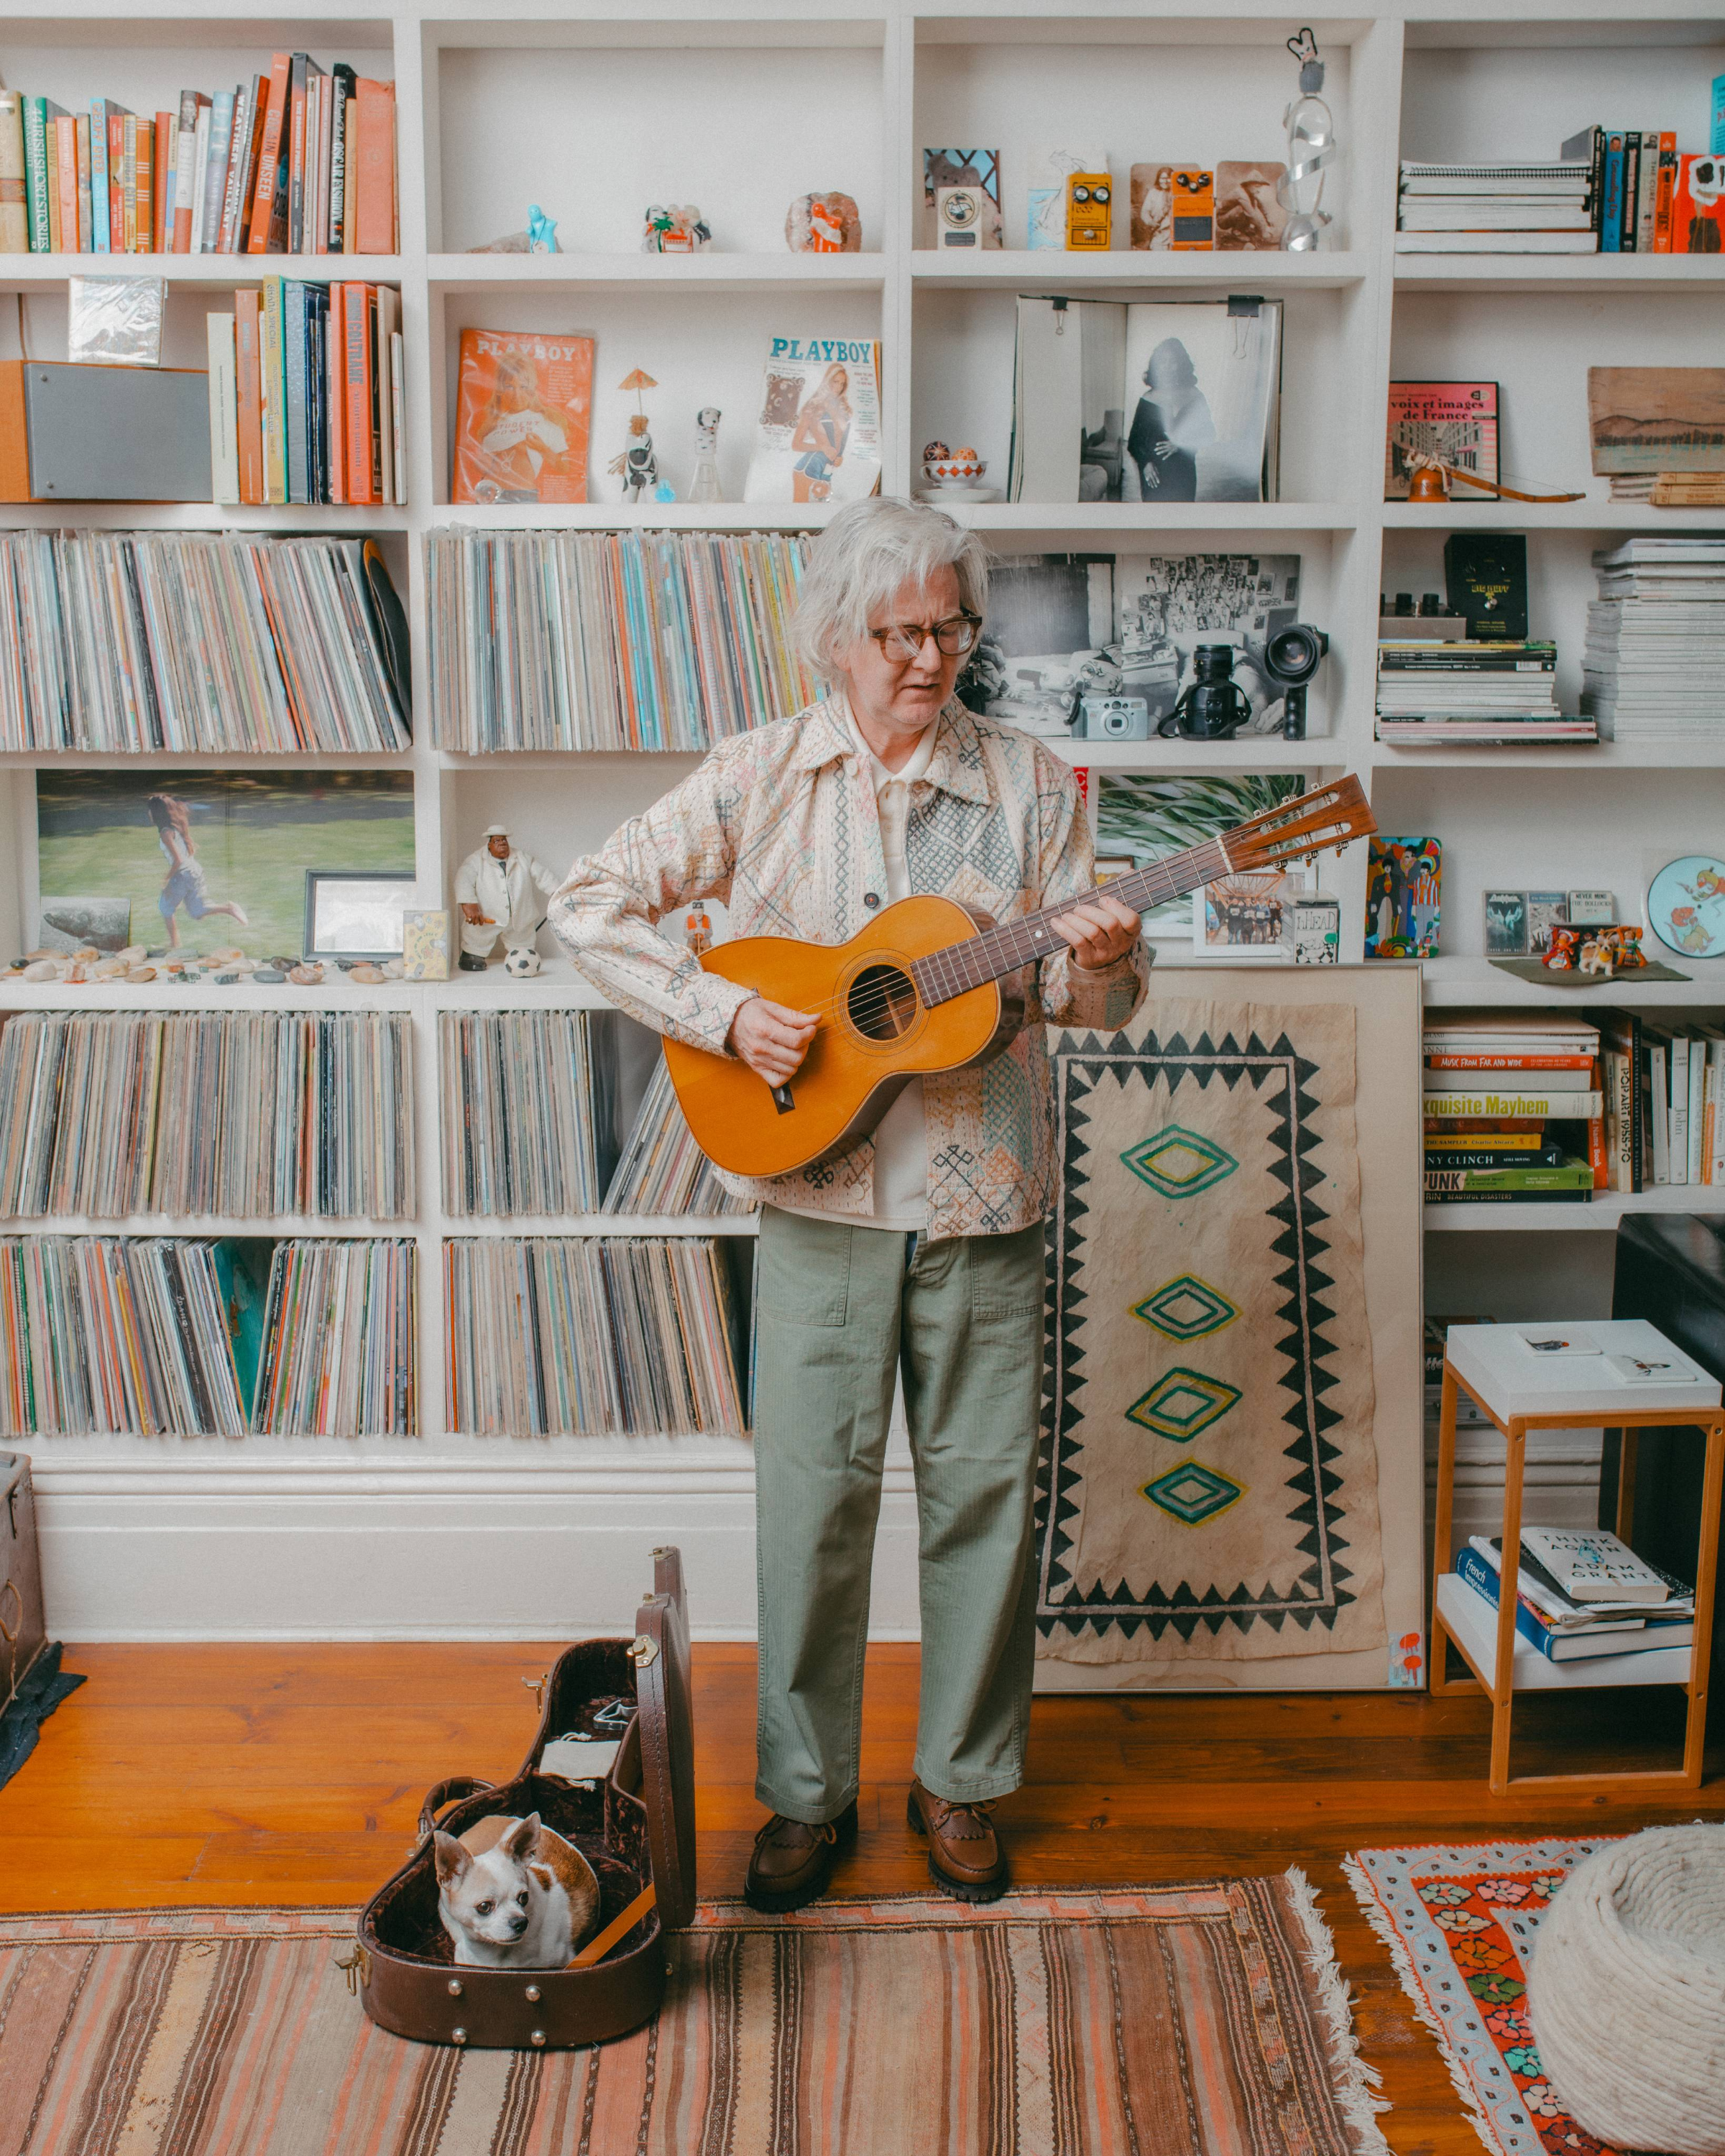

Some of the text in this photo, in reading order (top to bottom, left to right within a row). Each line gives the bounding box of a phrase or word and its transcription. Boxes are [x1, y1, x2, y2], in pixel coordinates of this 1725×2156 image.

[92, 103, 105, 173] GEOFF DYER
[211, 106, 229, 154] LIT
[231, 94, 246, 163] WEATHER
[48, 131, 57, 167] KURKOV
[332, 142, 344, 177] OSCAR
[32, 107, 48, 249] 44 IRISH SHORT STORIES
[257, 155, 275, 201] UNSEEN
[126, 187, 135, 210] CITY
[208, 172, 220, 234] MARY KARR
[222, 171, 235, 230] VAILLANT
[331, 178, 344, 221] FASHION
[267, 284, 277, 349] GHANA SPECIAL
[347, 290, 364, 384] JOHN COLTRANE
[477, 339, 576, 361] PLAYBOY
[770, 338, 871, 364] PLAYBOY
[1391, 397, 1484, 410] voix et images
[1403, 409, 1468, 420] de France
[1441, 1056, 1522, 1067] MUSIC FROM FAR AND WIDE
[1423, 1095, 1549, 1119] xquisite Mayhem
[1621, 1068, 1631, 1163] POP ART 1955-70
[1675, 1107, 1686, 1135] John
[1448, 1155, 1494, 1164] CLINCH
[1425, 1192, 1441, 1201] BIN
[1540, 1535, 1614, 1545] THINK
[1551, 1544, 1621, 1553] AGAIN
[1466, 1558, 1486, 1583] French
[1465, 1570, 1499, 1609] Impressionis
